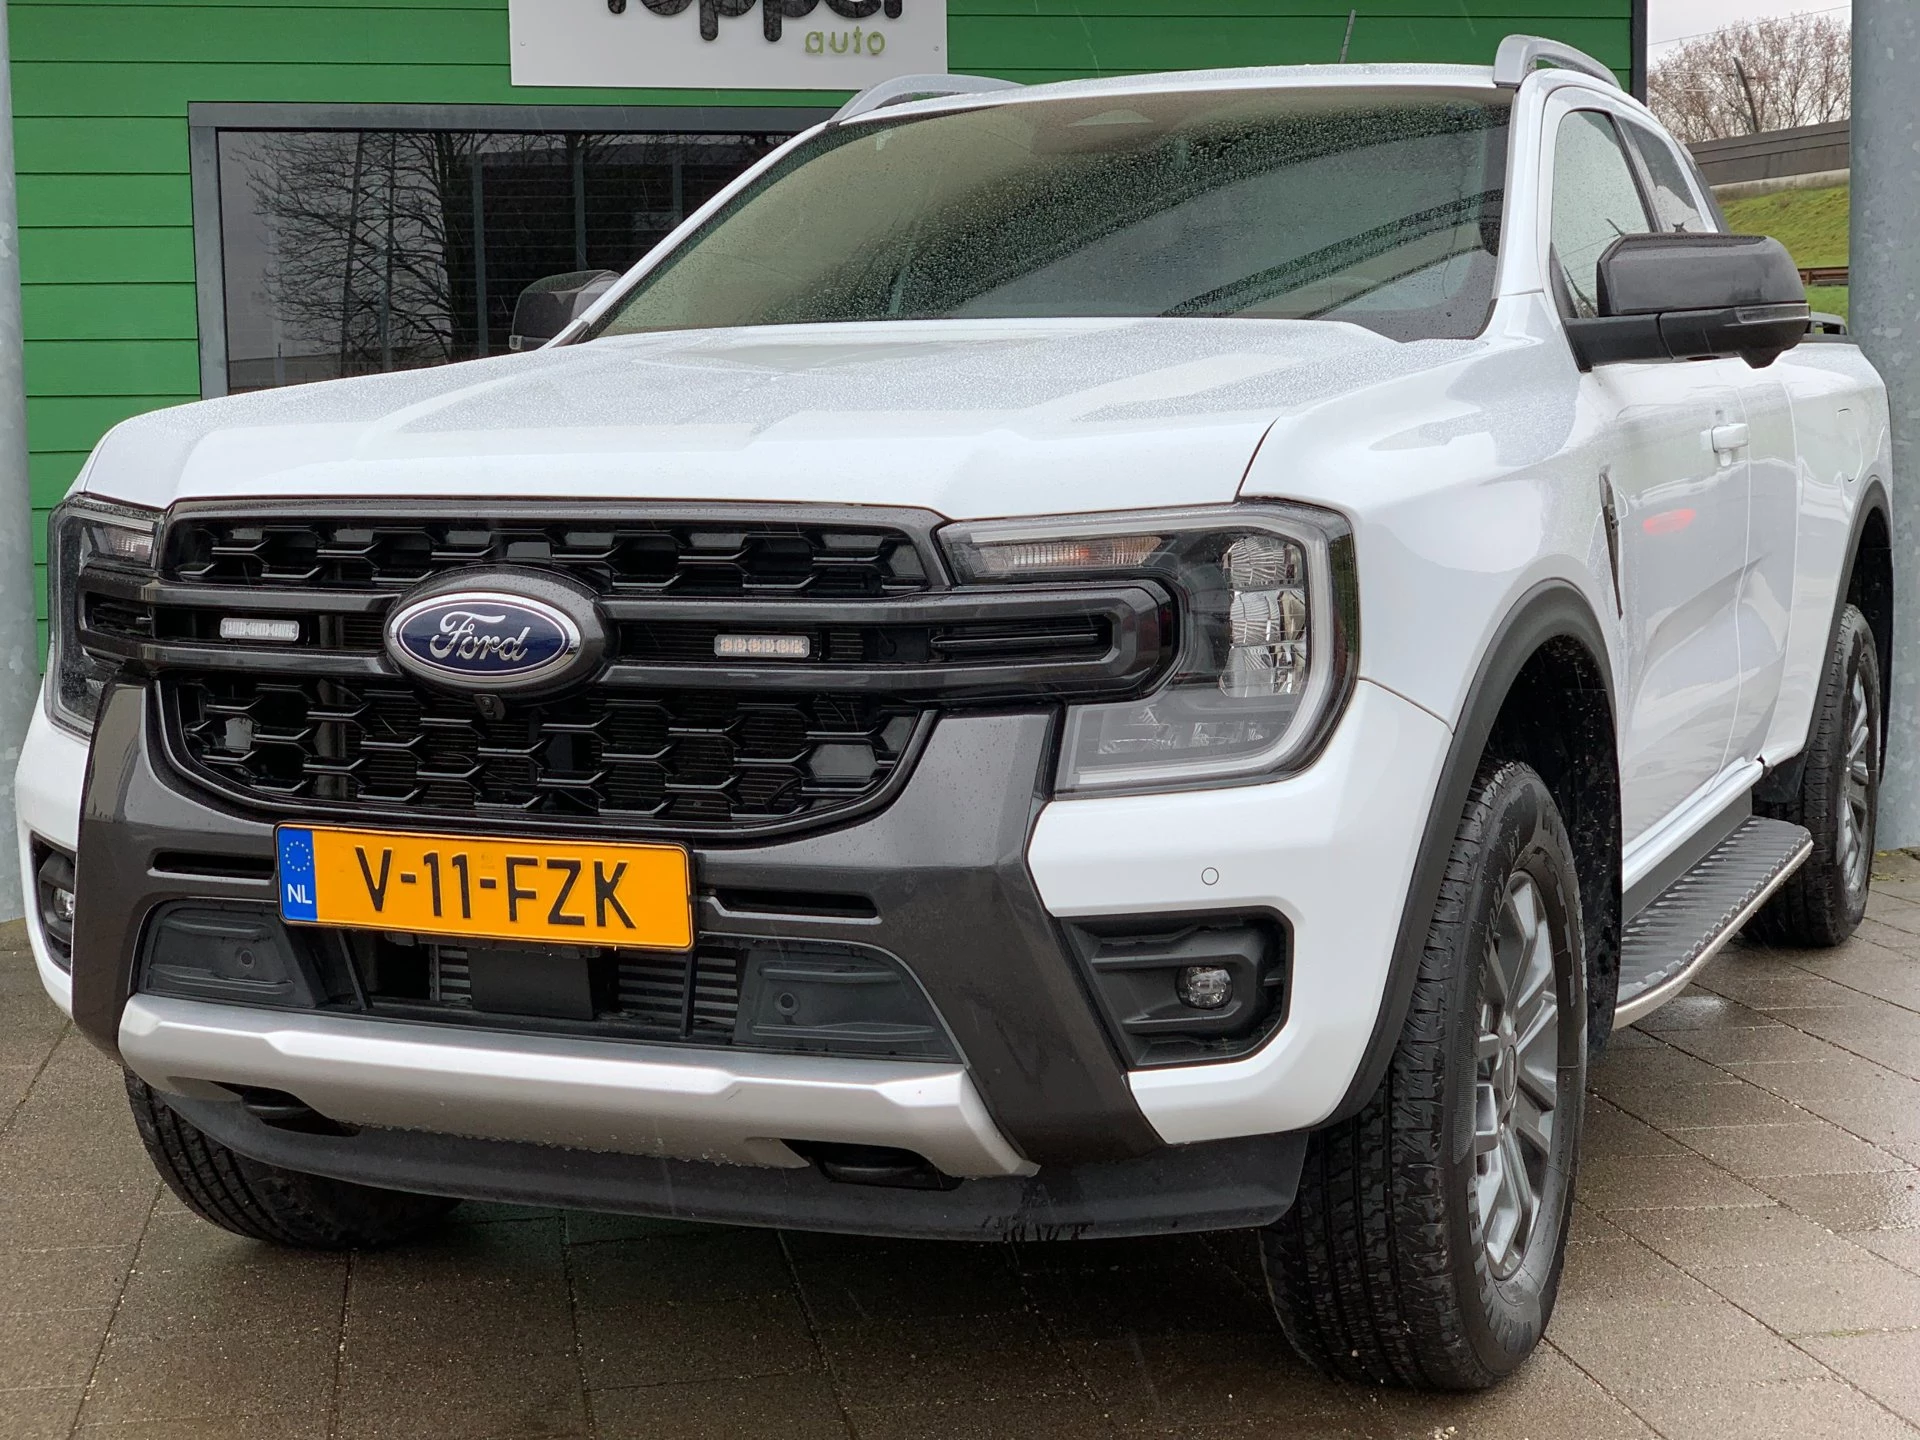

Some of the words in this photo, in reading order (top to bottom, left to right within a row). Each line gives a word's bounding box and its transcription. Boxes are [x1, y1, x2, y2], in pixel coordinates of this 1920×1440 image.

[804, 26, 886, 55] auto
[429, 611, 531, 661] Ford
[287, 883, 313, 905] NL
[354, 846, 637, 929] V-11-FZK
